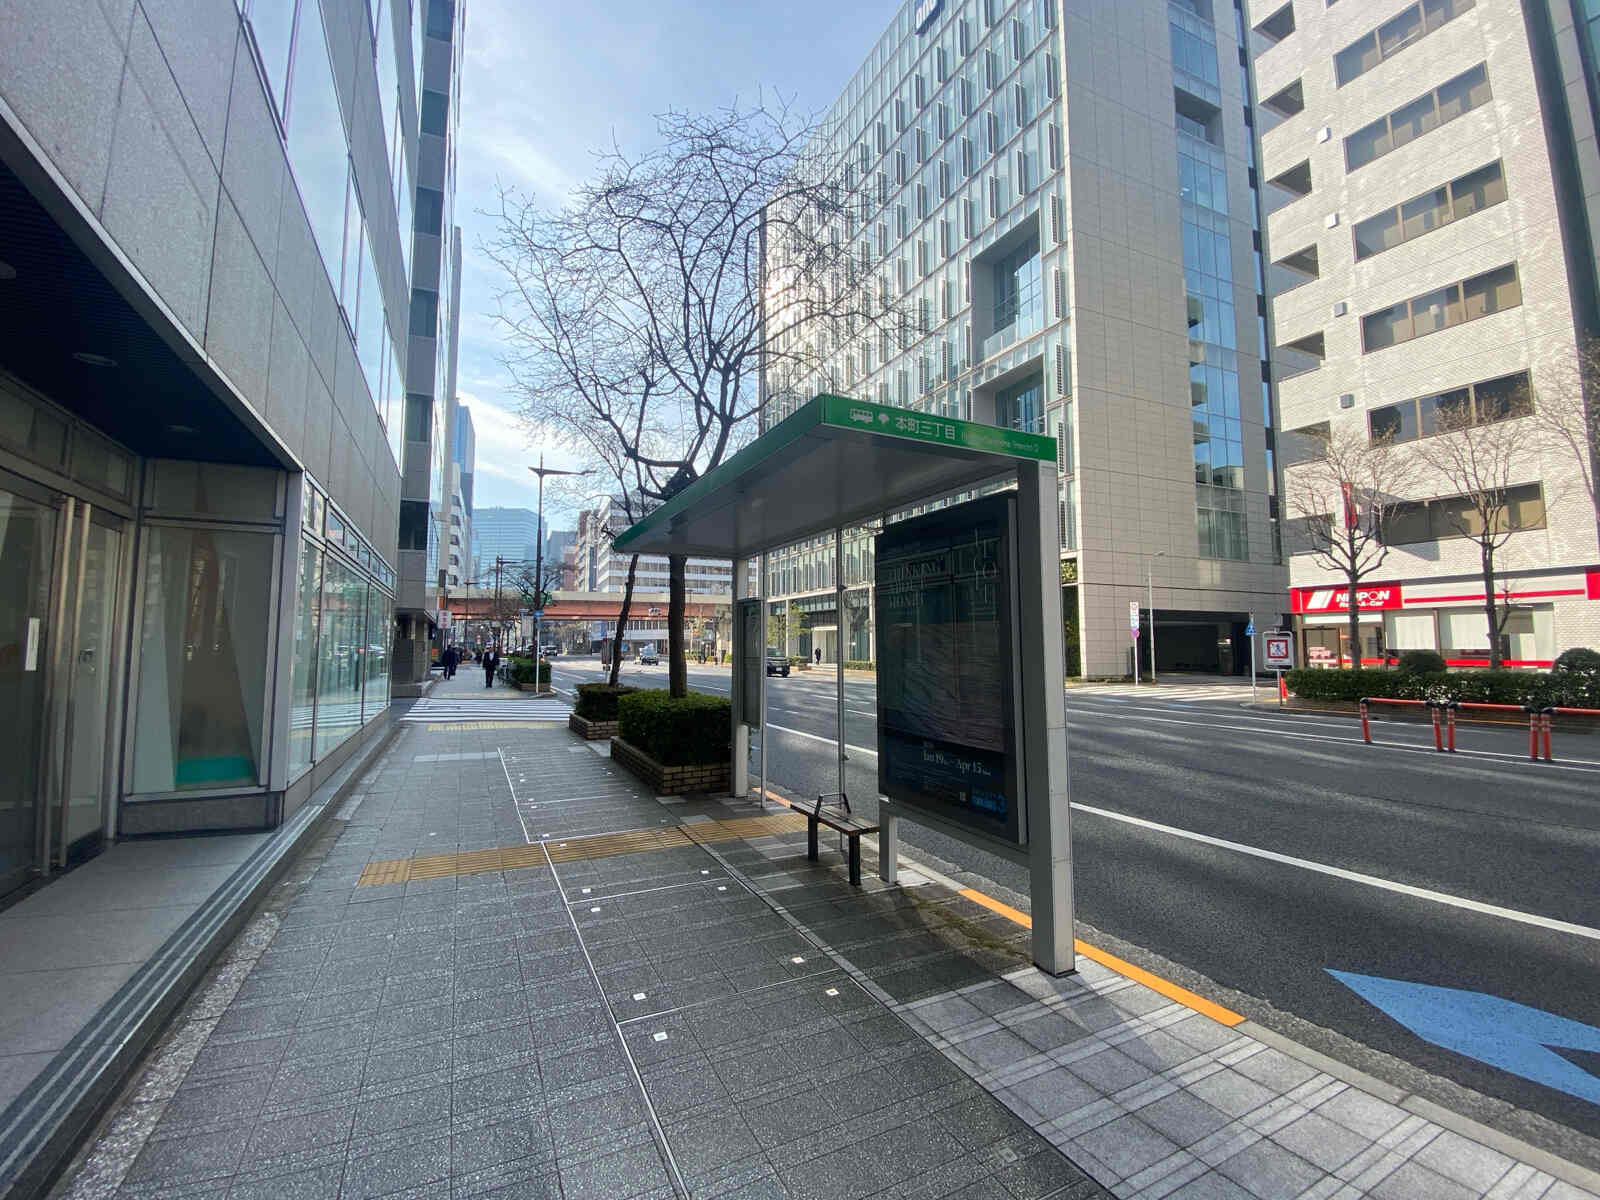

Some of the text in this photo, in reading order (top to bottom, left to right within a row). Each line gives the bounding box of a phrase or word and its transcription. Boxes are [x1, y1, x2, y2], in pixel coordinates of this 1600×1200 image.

[895, 415, 956, 440] 本町三丁目
[1336, 590, 1390, 602] NIPON
